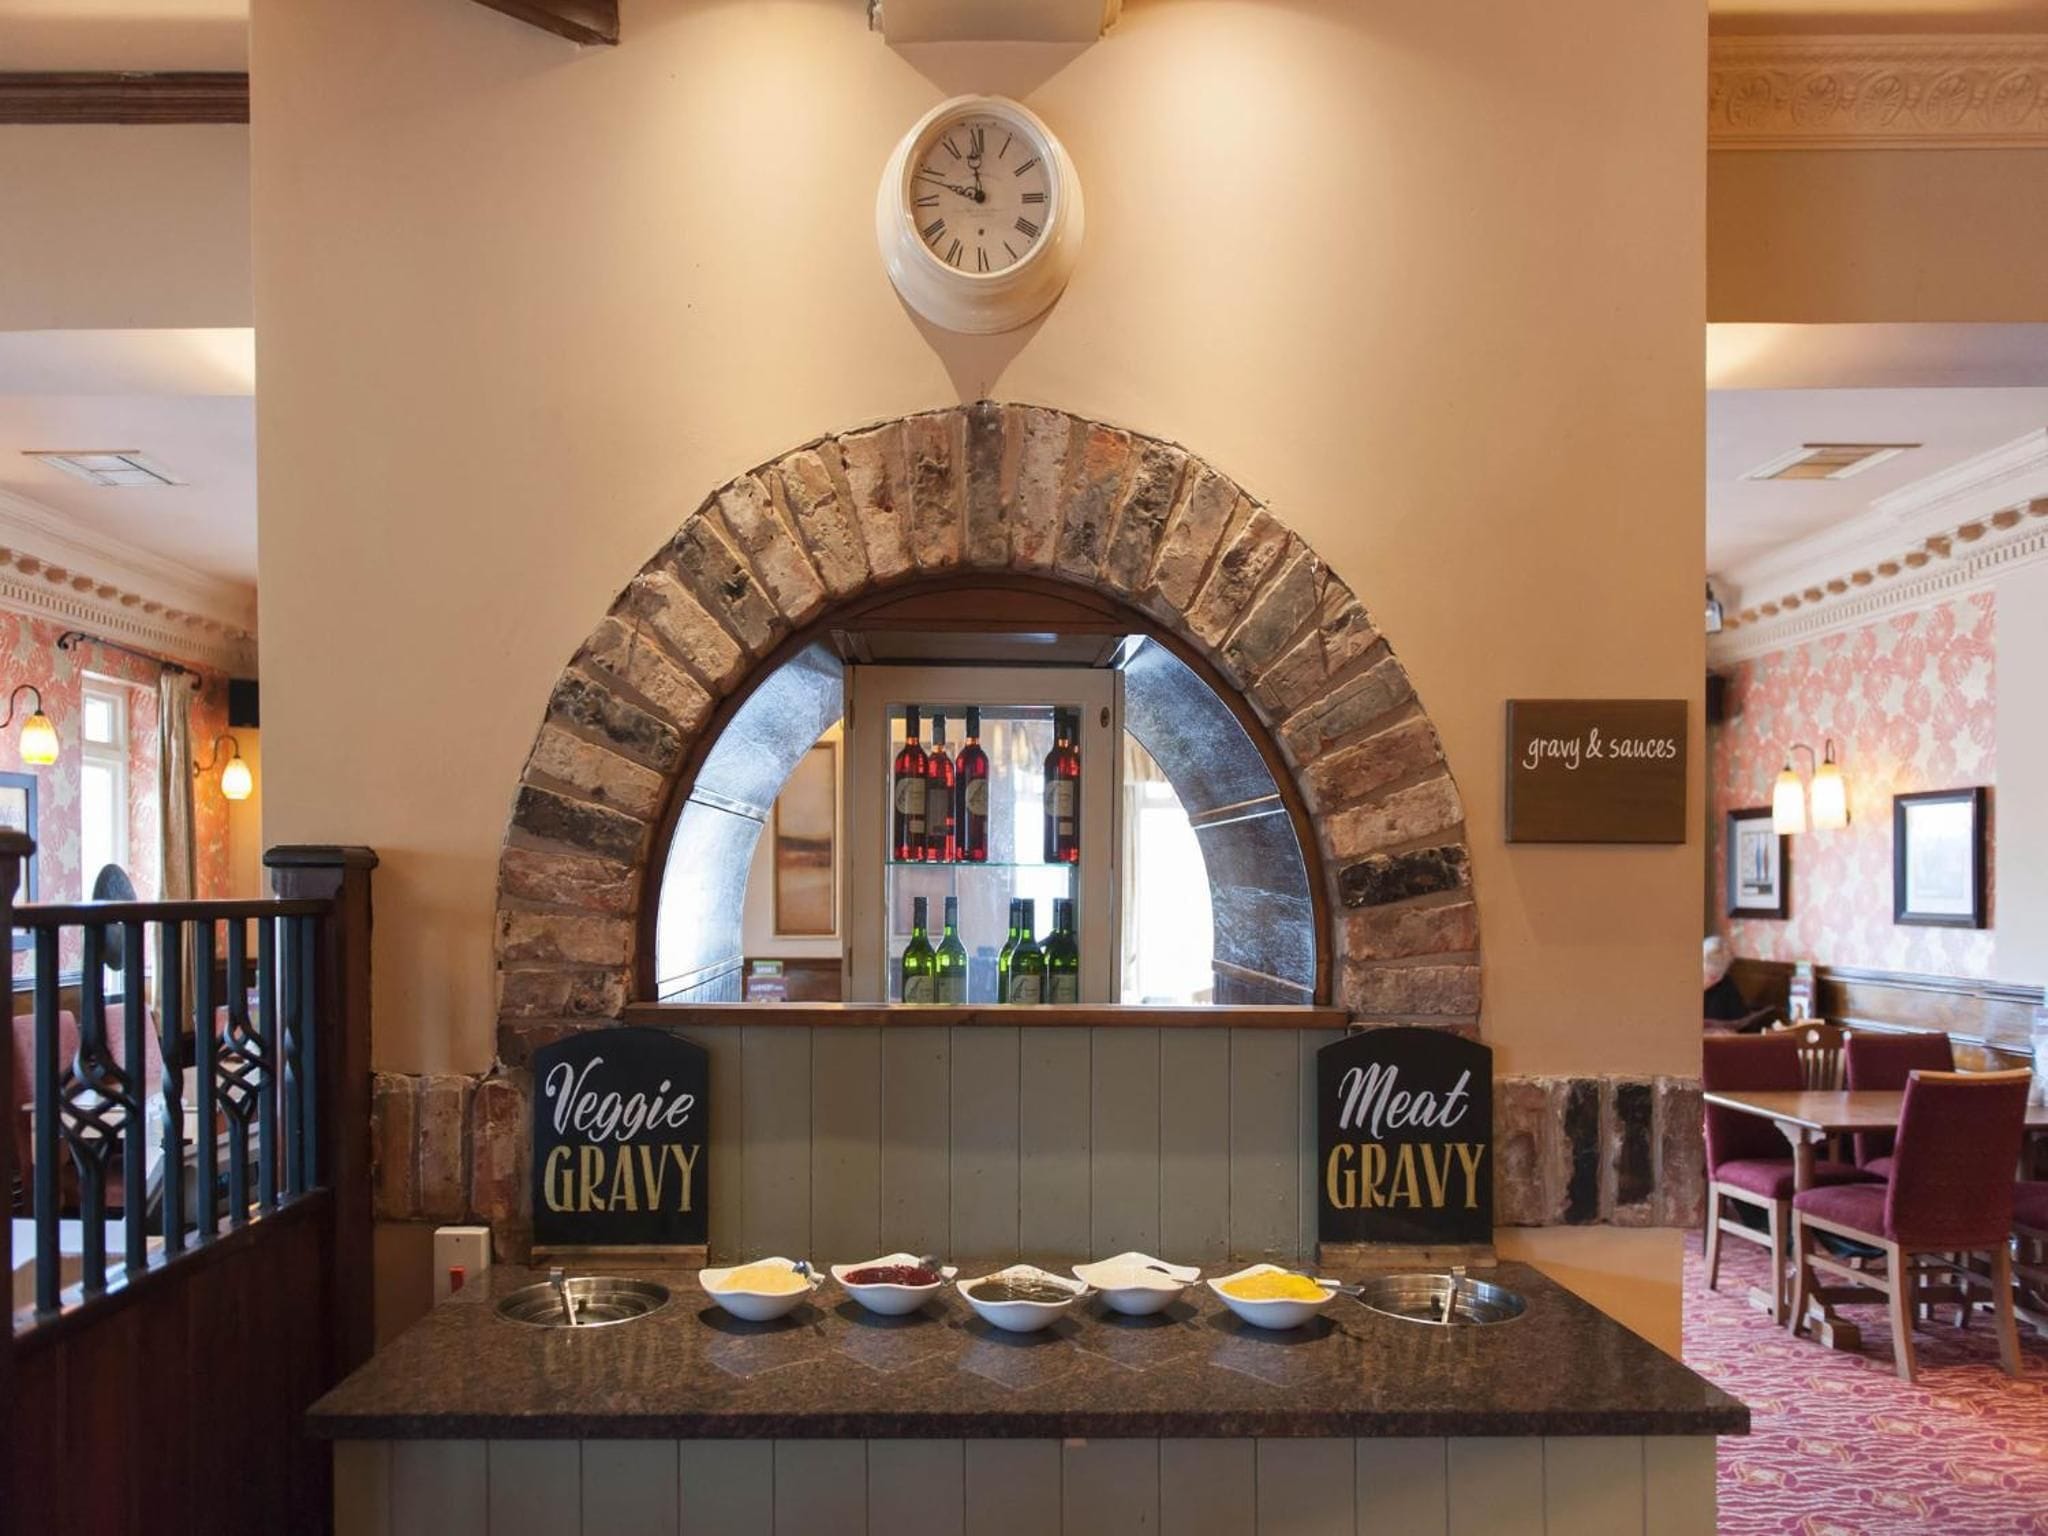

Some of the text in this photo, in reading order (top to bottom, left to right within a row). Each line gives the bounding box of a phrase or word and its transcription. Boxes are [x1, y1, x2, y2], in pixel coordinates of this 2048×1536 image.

[1021, 192, 1045, 204] III
[1522, 727, 1678, 770] gravy & sauces
[545, 1056, 695, 1143] Veggie
[1337, 1061, 1472, 1140] Meat
[544, 1143, 701, 1212] GRAVY
[1326, 1142, 1487, 1209] GRAVY
